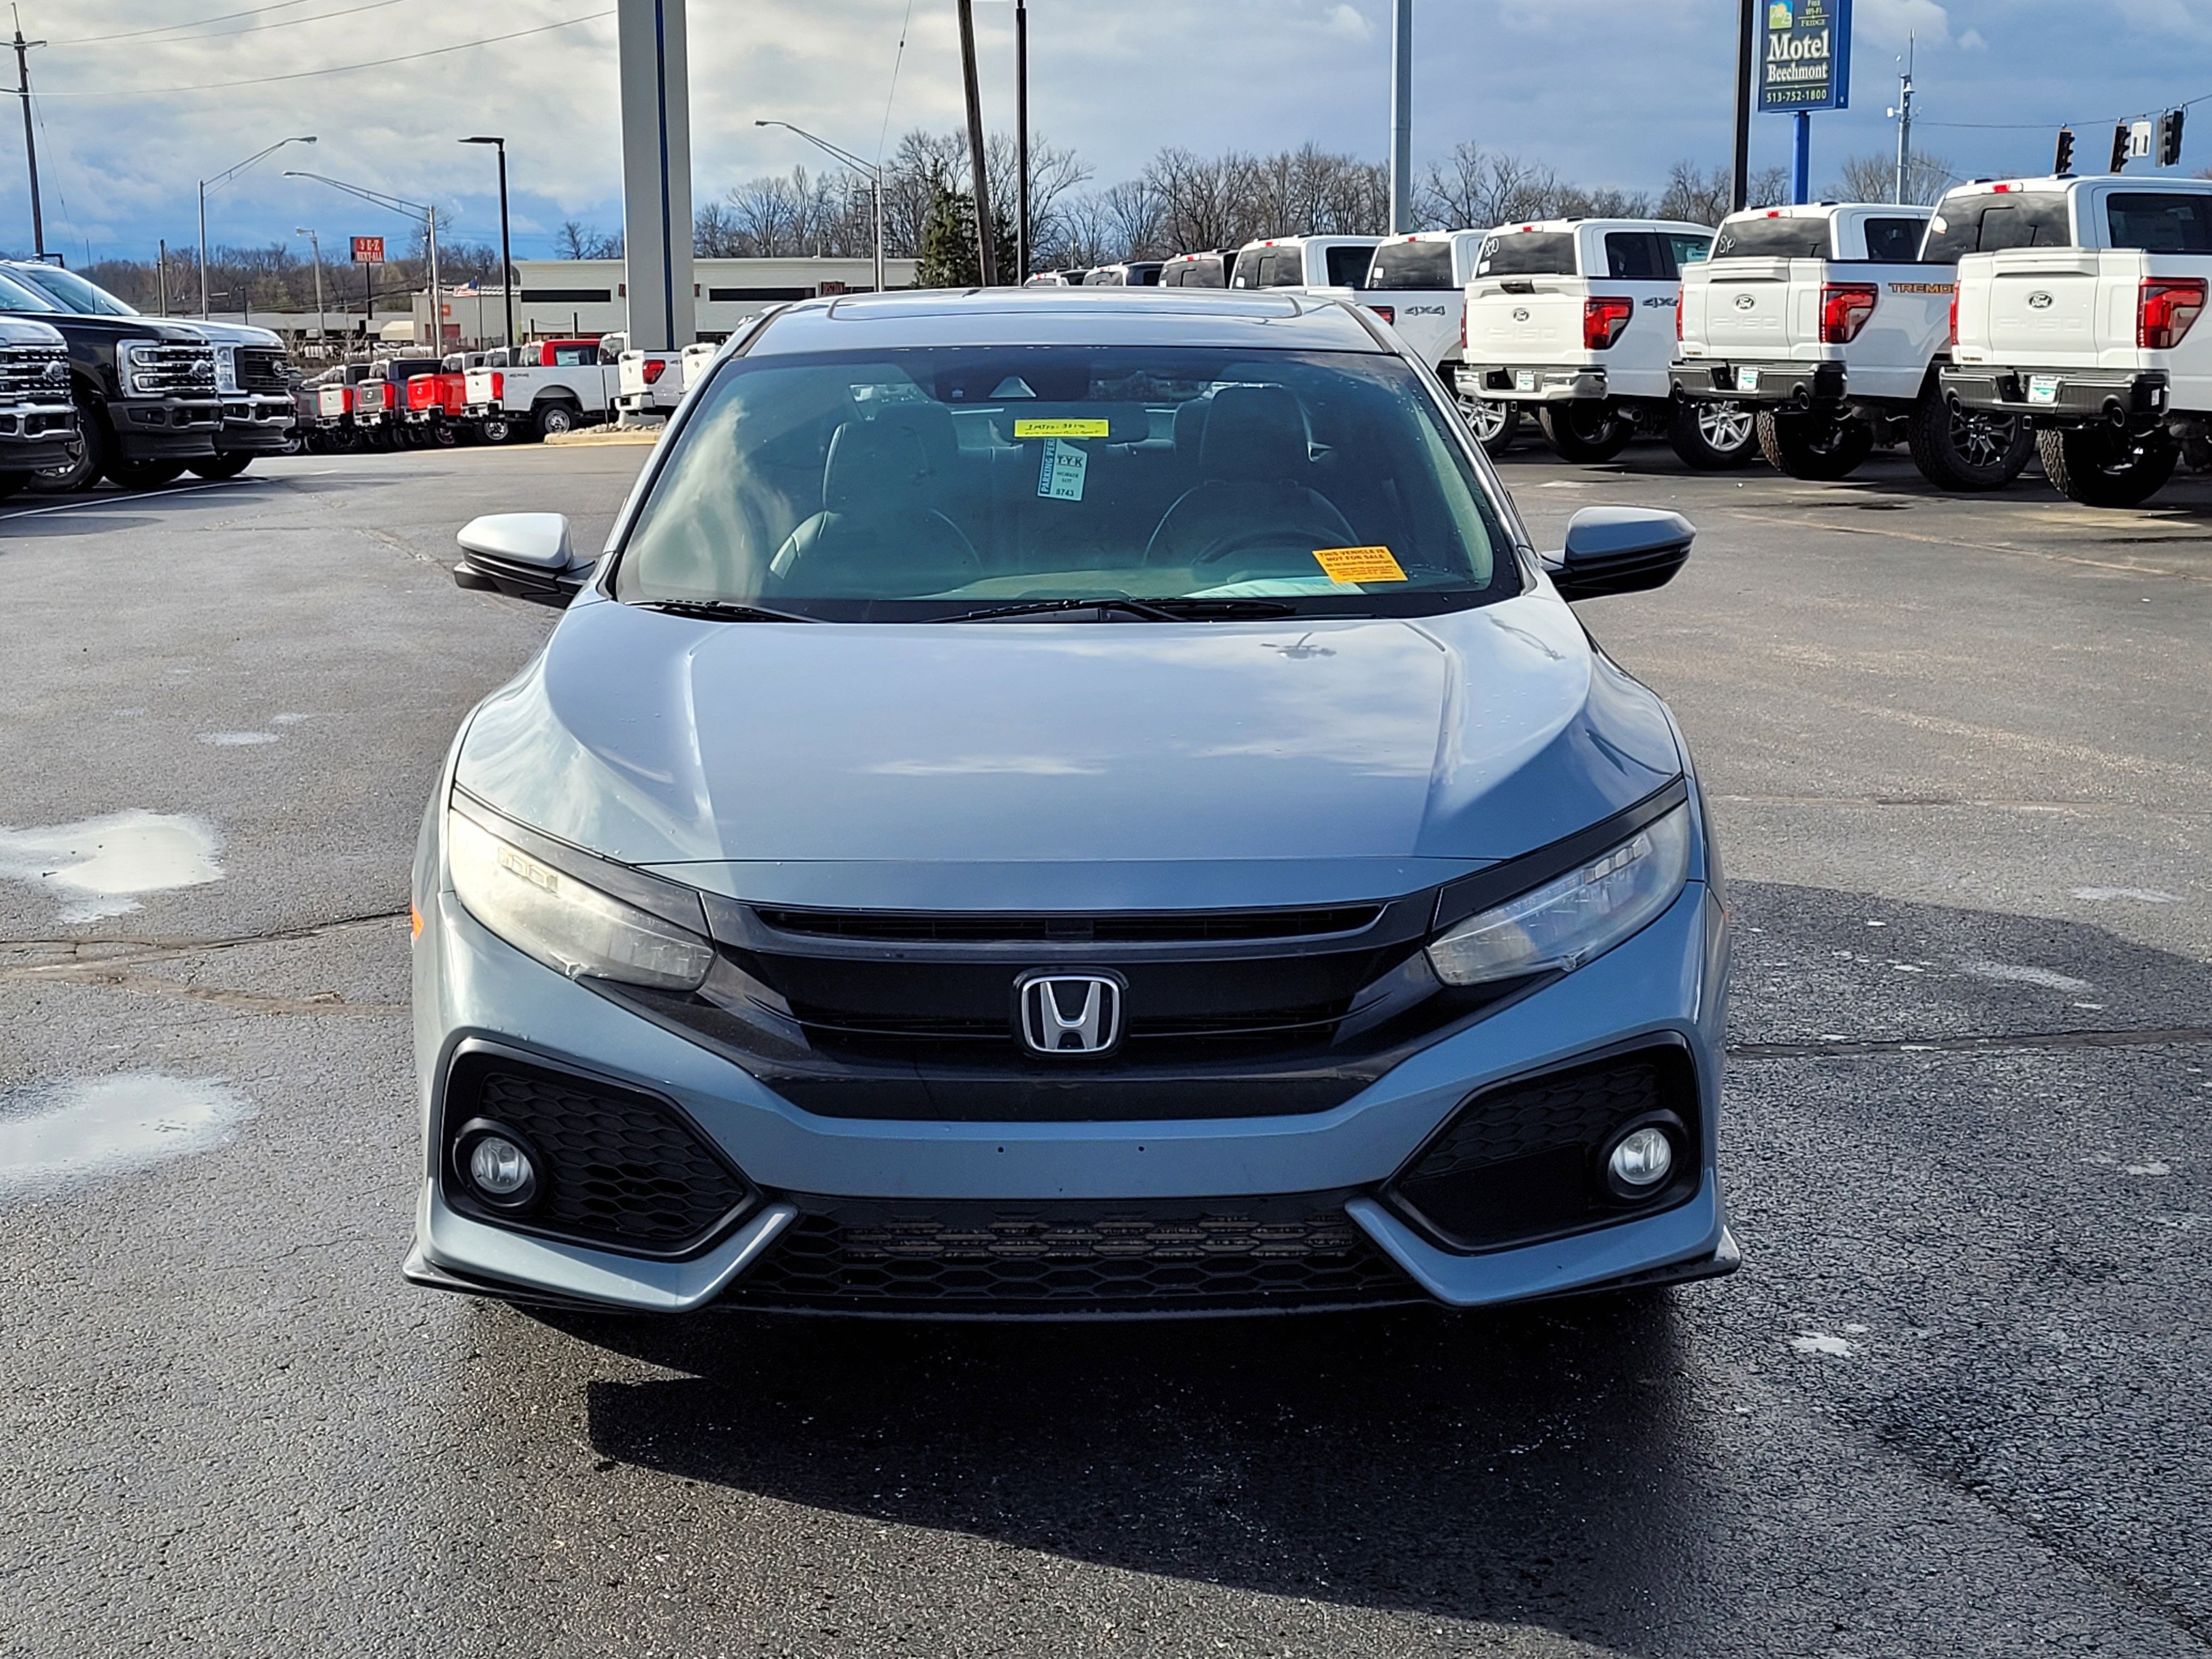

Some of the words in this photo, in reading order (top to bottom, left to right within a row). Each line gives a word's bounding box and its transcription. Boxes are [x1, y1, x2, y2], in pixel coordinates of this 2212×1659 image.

[1767, 29, 1831, 61] Motel
[1767, 62, 1829, 83] Beechmont
[1767, 89, 1827, 103] 513-752-1800
[1888, 283, 1954, 294] TREMO
